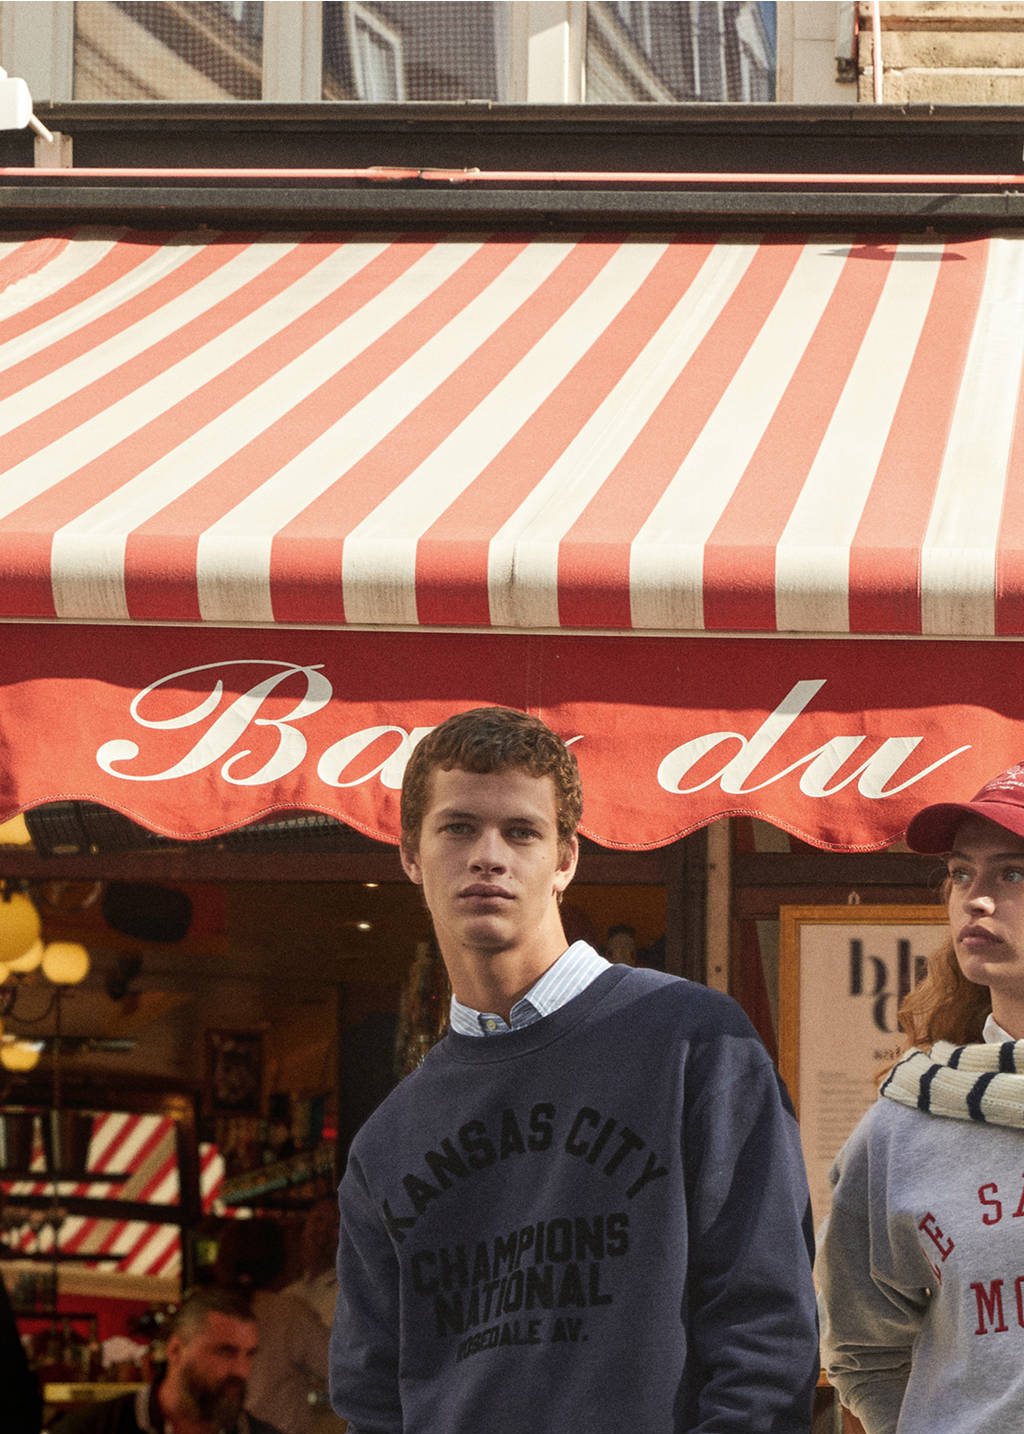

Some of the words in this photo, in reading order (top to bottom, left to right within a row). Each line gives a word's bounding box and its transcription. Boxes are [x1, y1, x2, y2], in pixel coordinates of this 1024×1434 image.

[96, 659, 582, 789] Ba
[657, 678, 972, 798] du
[383, 1103, 556, 1242] KANSAS
[564, 1106, 669, 1200] CITY
[411, 1212, 629, 1296] CHAMPIONS
[434, 1262, 613, 1337] NATIONAL
[550, 1317, 590, 1343] AV.
